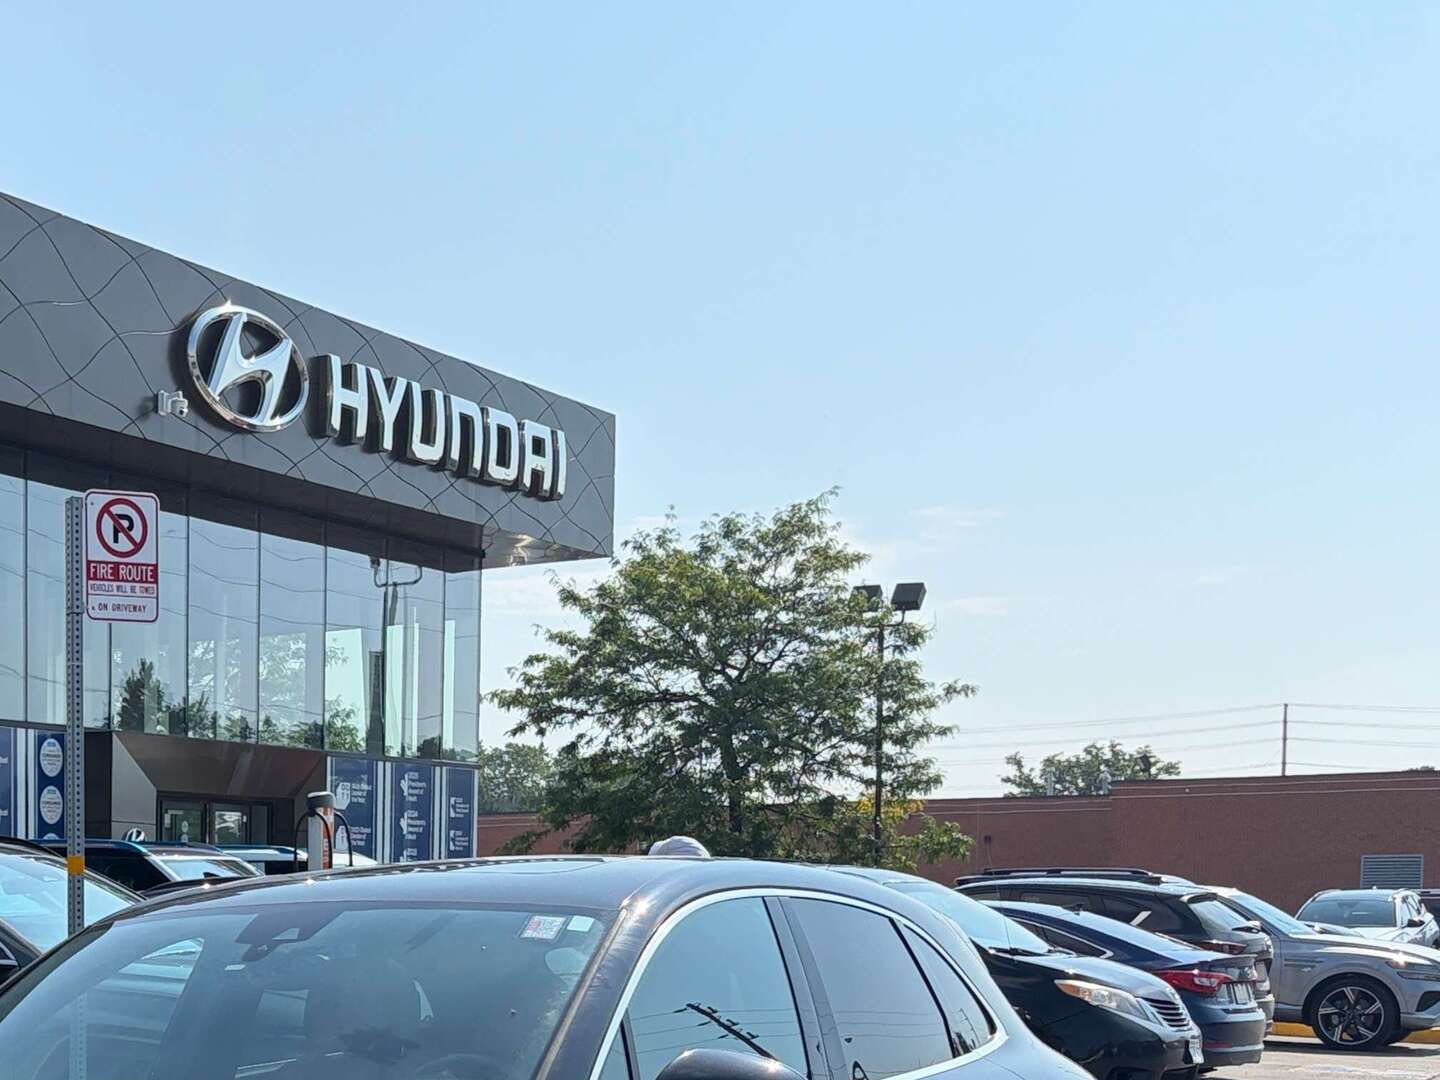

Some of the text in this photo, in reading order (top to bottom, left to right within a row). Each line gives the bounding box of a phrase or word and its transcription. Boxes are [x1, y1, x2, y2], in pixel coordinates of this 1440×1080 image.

[326, 354, 566, 499] HYUNDAI
[90, 563, 155, 581] FIRE ROUTE
[90, 583, 114, 592] VEHICLES
[116, 585, 129, 593] WILL
[98, 602, 146, 613] ON DRIVEWAY
